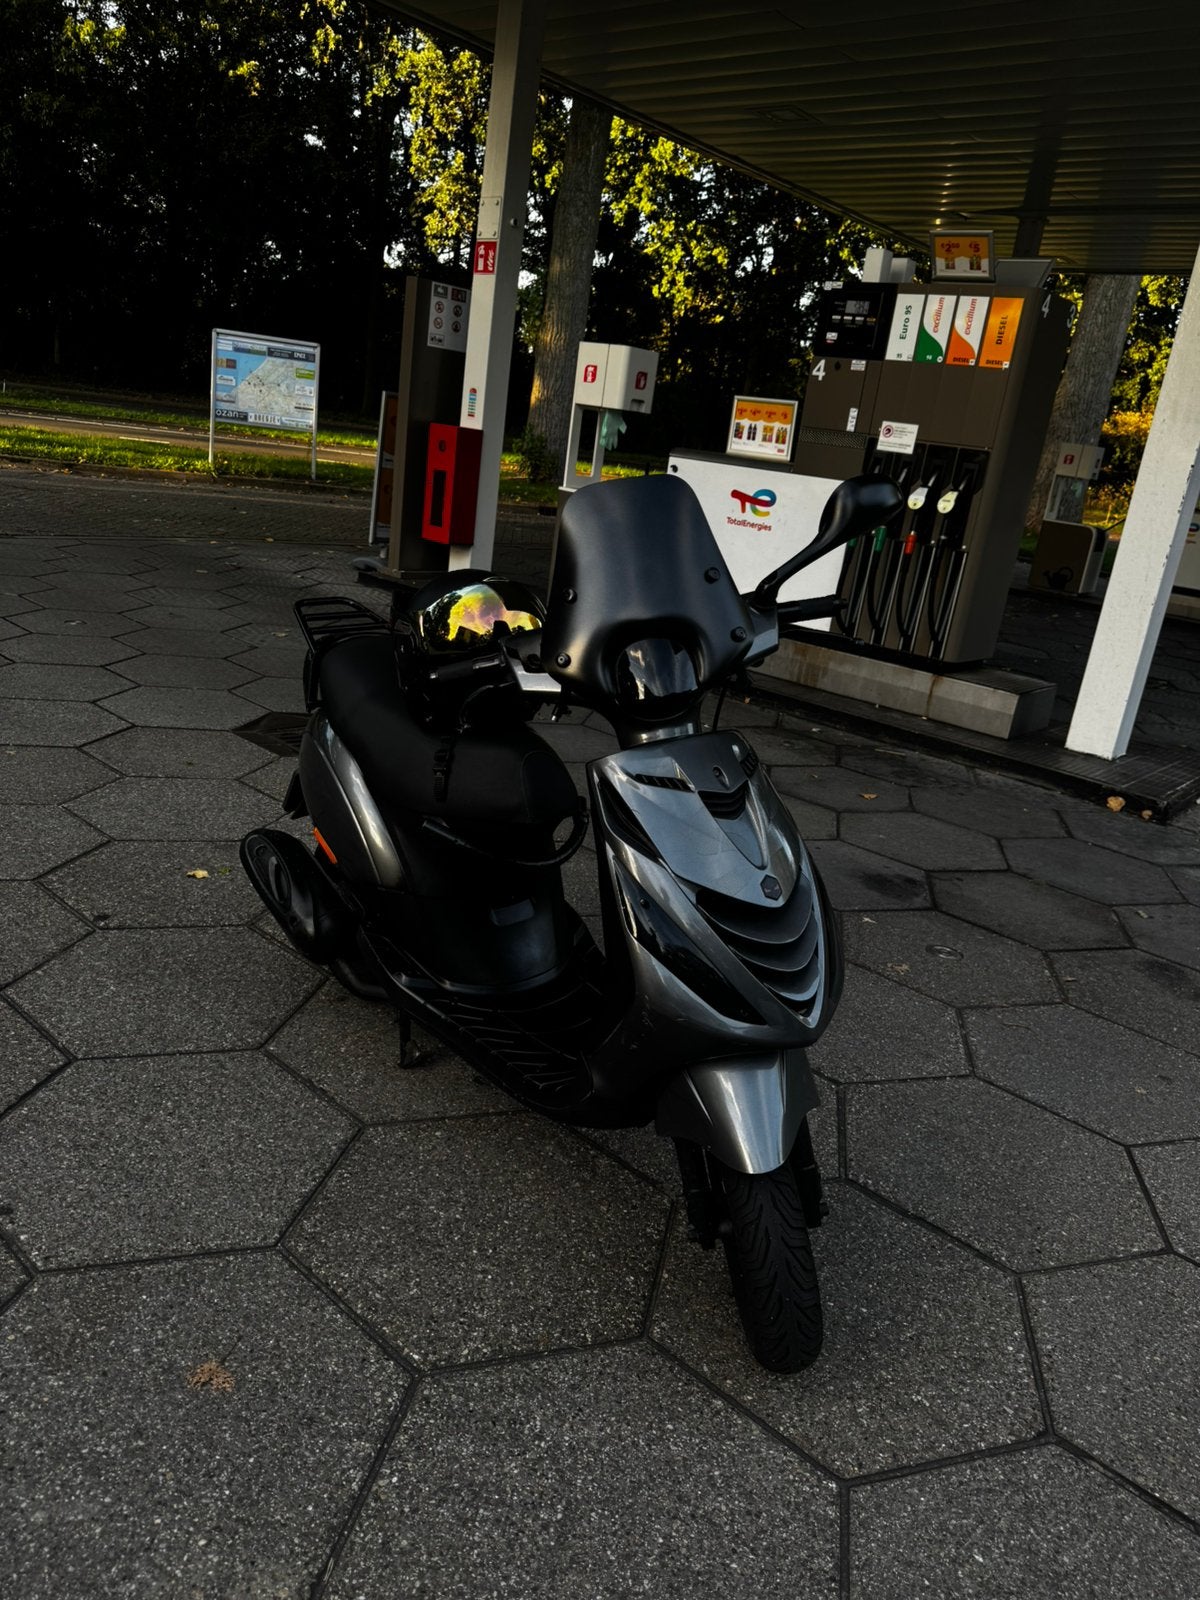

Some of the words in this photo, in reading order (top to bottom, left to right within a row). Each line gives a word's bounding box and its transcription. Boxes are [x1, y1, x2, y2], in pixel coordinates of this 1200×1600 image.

[904, 305, 913, 315] 95
[932, 297, 945, 334] excellium
[964, 298, 977, 336] excellium
[1041, 293, 1052, 318] 4
[1066, 304, 1077, 329] 3
[899, 318, 911, 340] Euro
[995, 315, 1008, 345] DIESEL
[811, 358, 827, 382] 4
[726, 516, 773, 532] TotalEnergies
